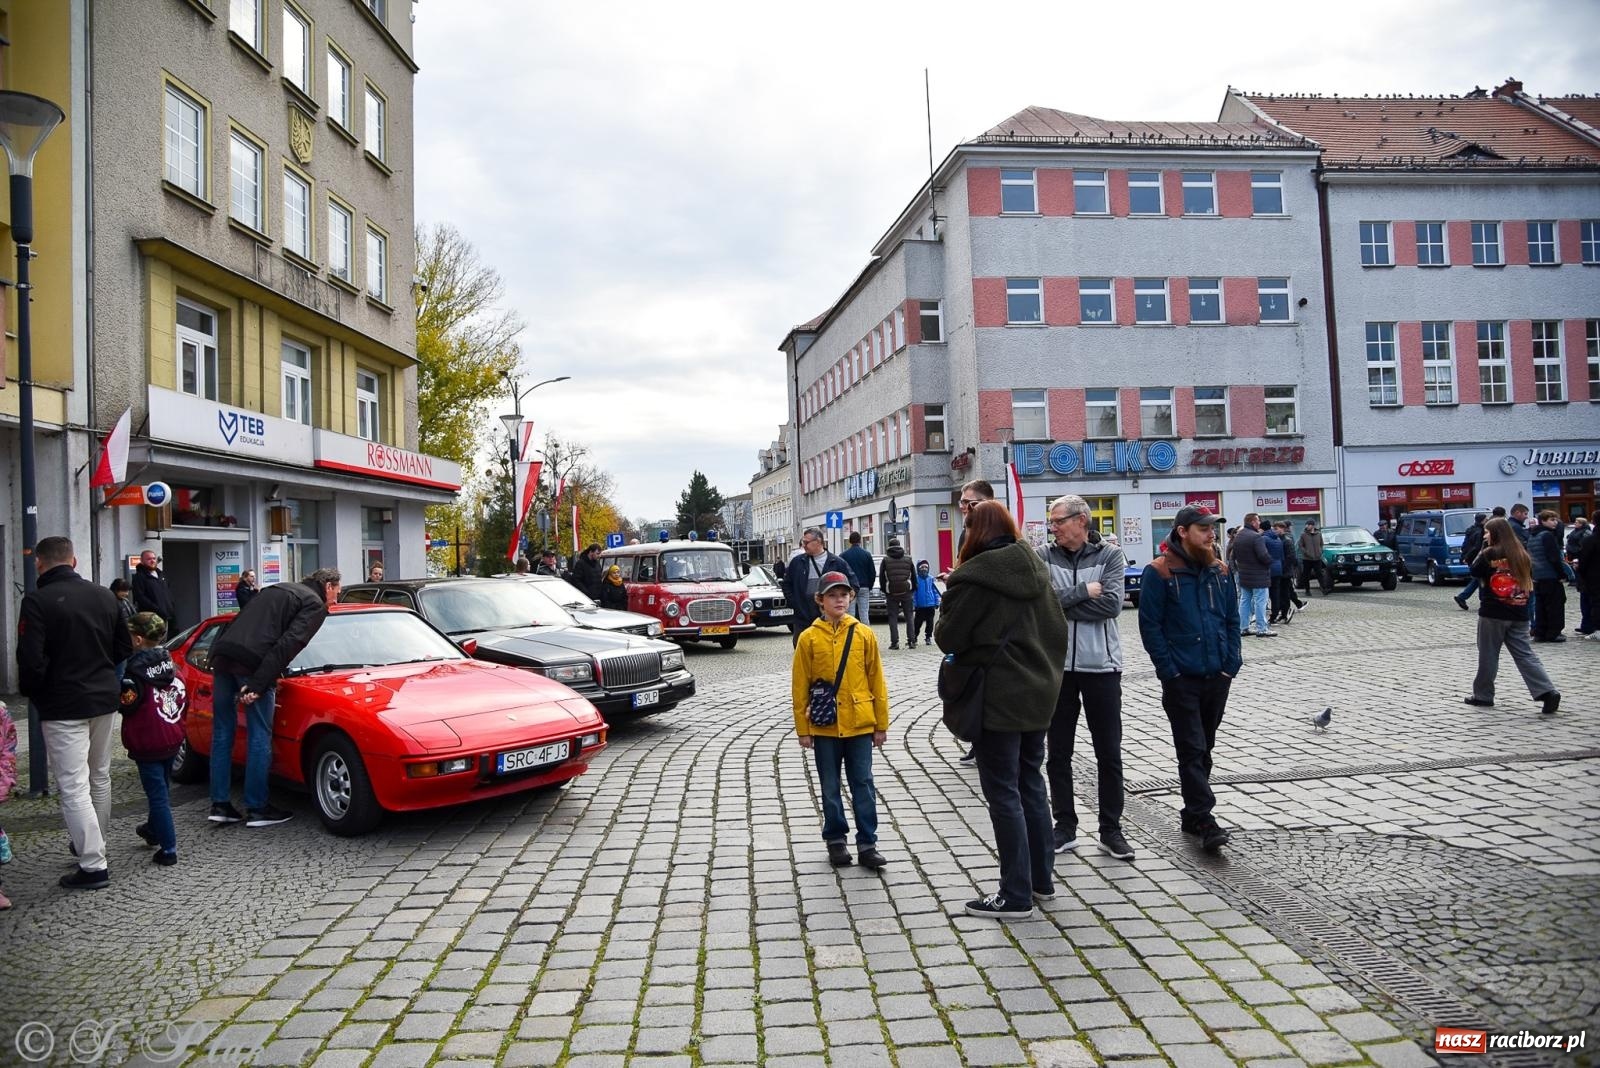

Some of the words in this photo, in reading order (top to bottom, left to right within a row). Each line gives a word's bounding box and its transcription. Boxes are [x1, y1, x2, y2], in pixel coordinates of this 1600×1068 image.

[240, 414, 264, 436] TEB
[240, 435, 265, 446] EDUKACJA
[367, 442, 432, 478] ROSSMANN
[1014, 440, 1177, 476] BOLKO
[1190, 446, 1305, 470] zaprasza
[1524, 448, 1600, 466] JUBILE
[1536, 468, 1597, 478] ZEGARMISTRZ
[1161, 500, 1182, 508] Bliski
[1264, 497, 1284, 505] Bliski
[612, 534, 622, 546] P
[506, 750, 535, 770] SRC
[538, 743, 568, 763] 4FJ3
